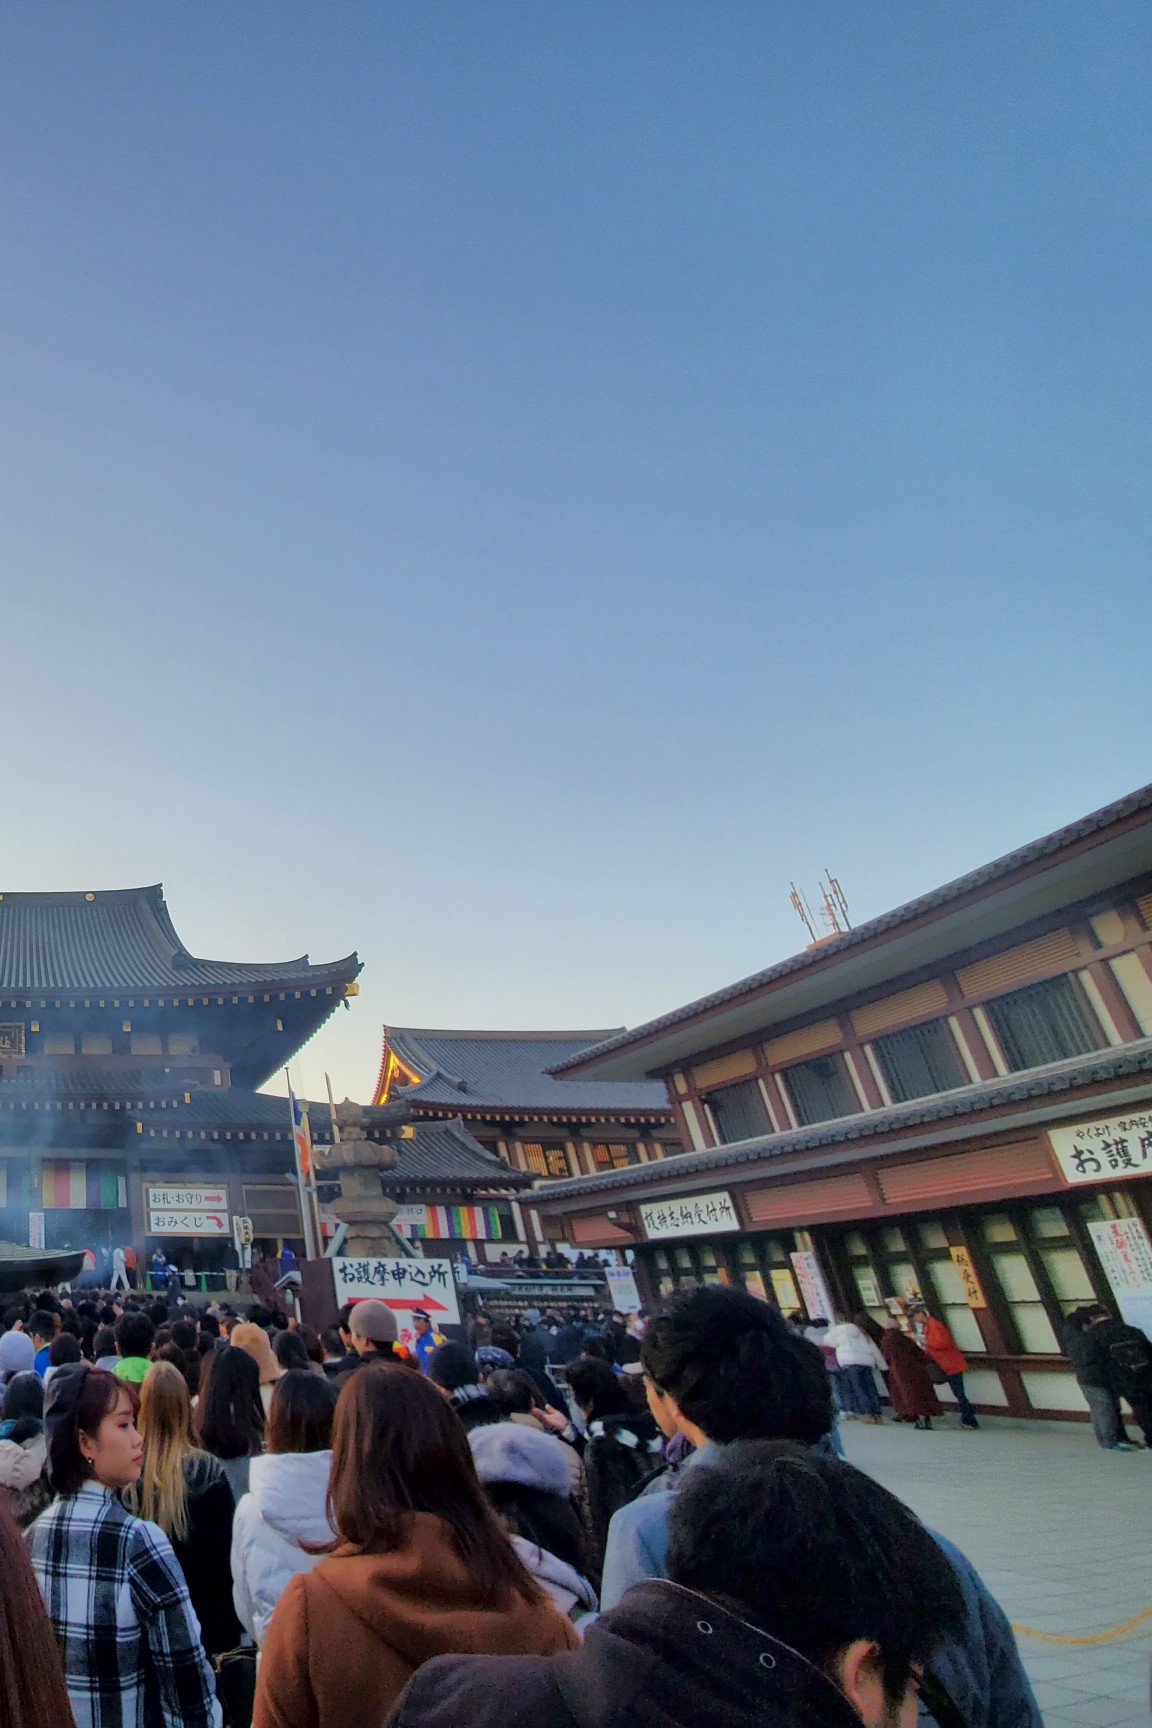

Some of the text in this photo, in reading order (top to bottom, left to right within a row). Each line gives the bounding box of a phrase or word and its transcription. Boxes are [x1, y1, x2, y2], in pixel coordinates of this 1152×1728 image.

[154, 1216, 204, 1228] おみくじ
[338, 1261, 448, 1288] お護摩申込所
